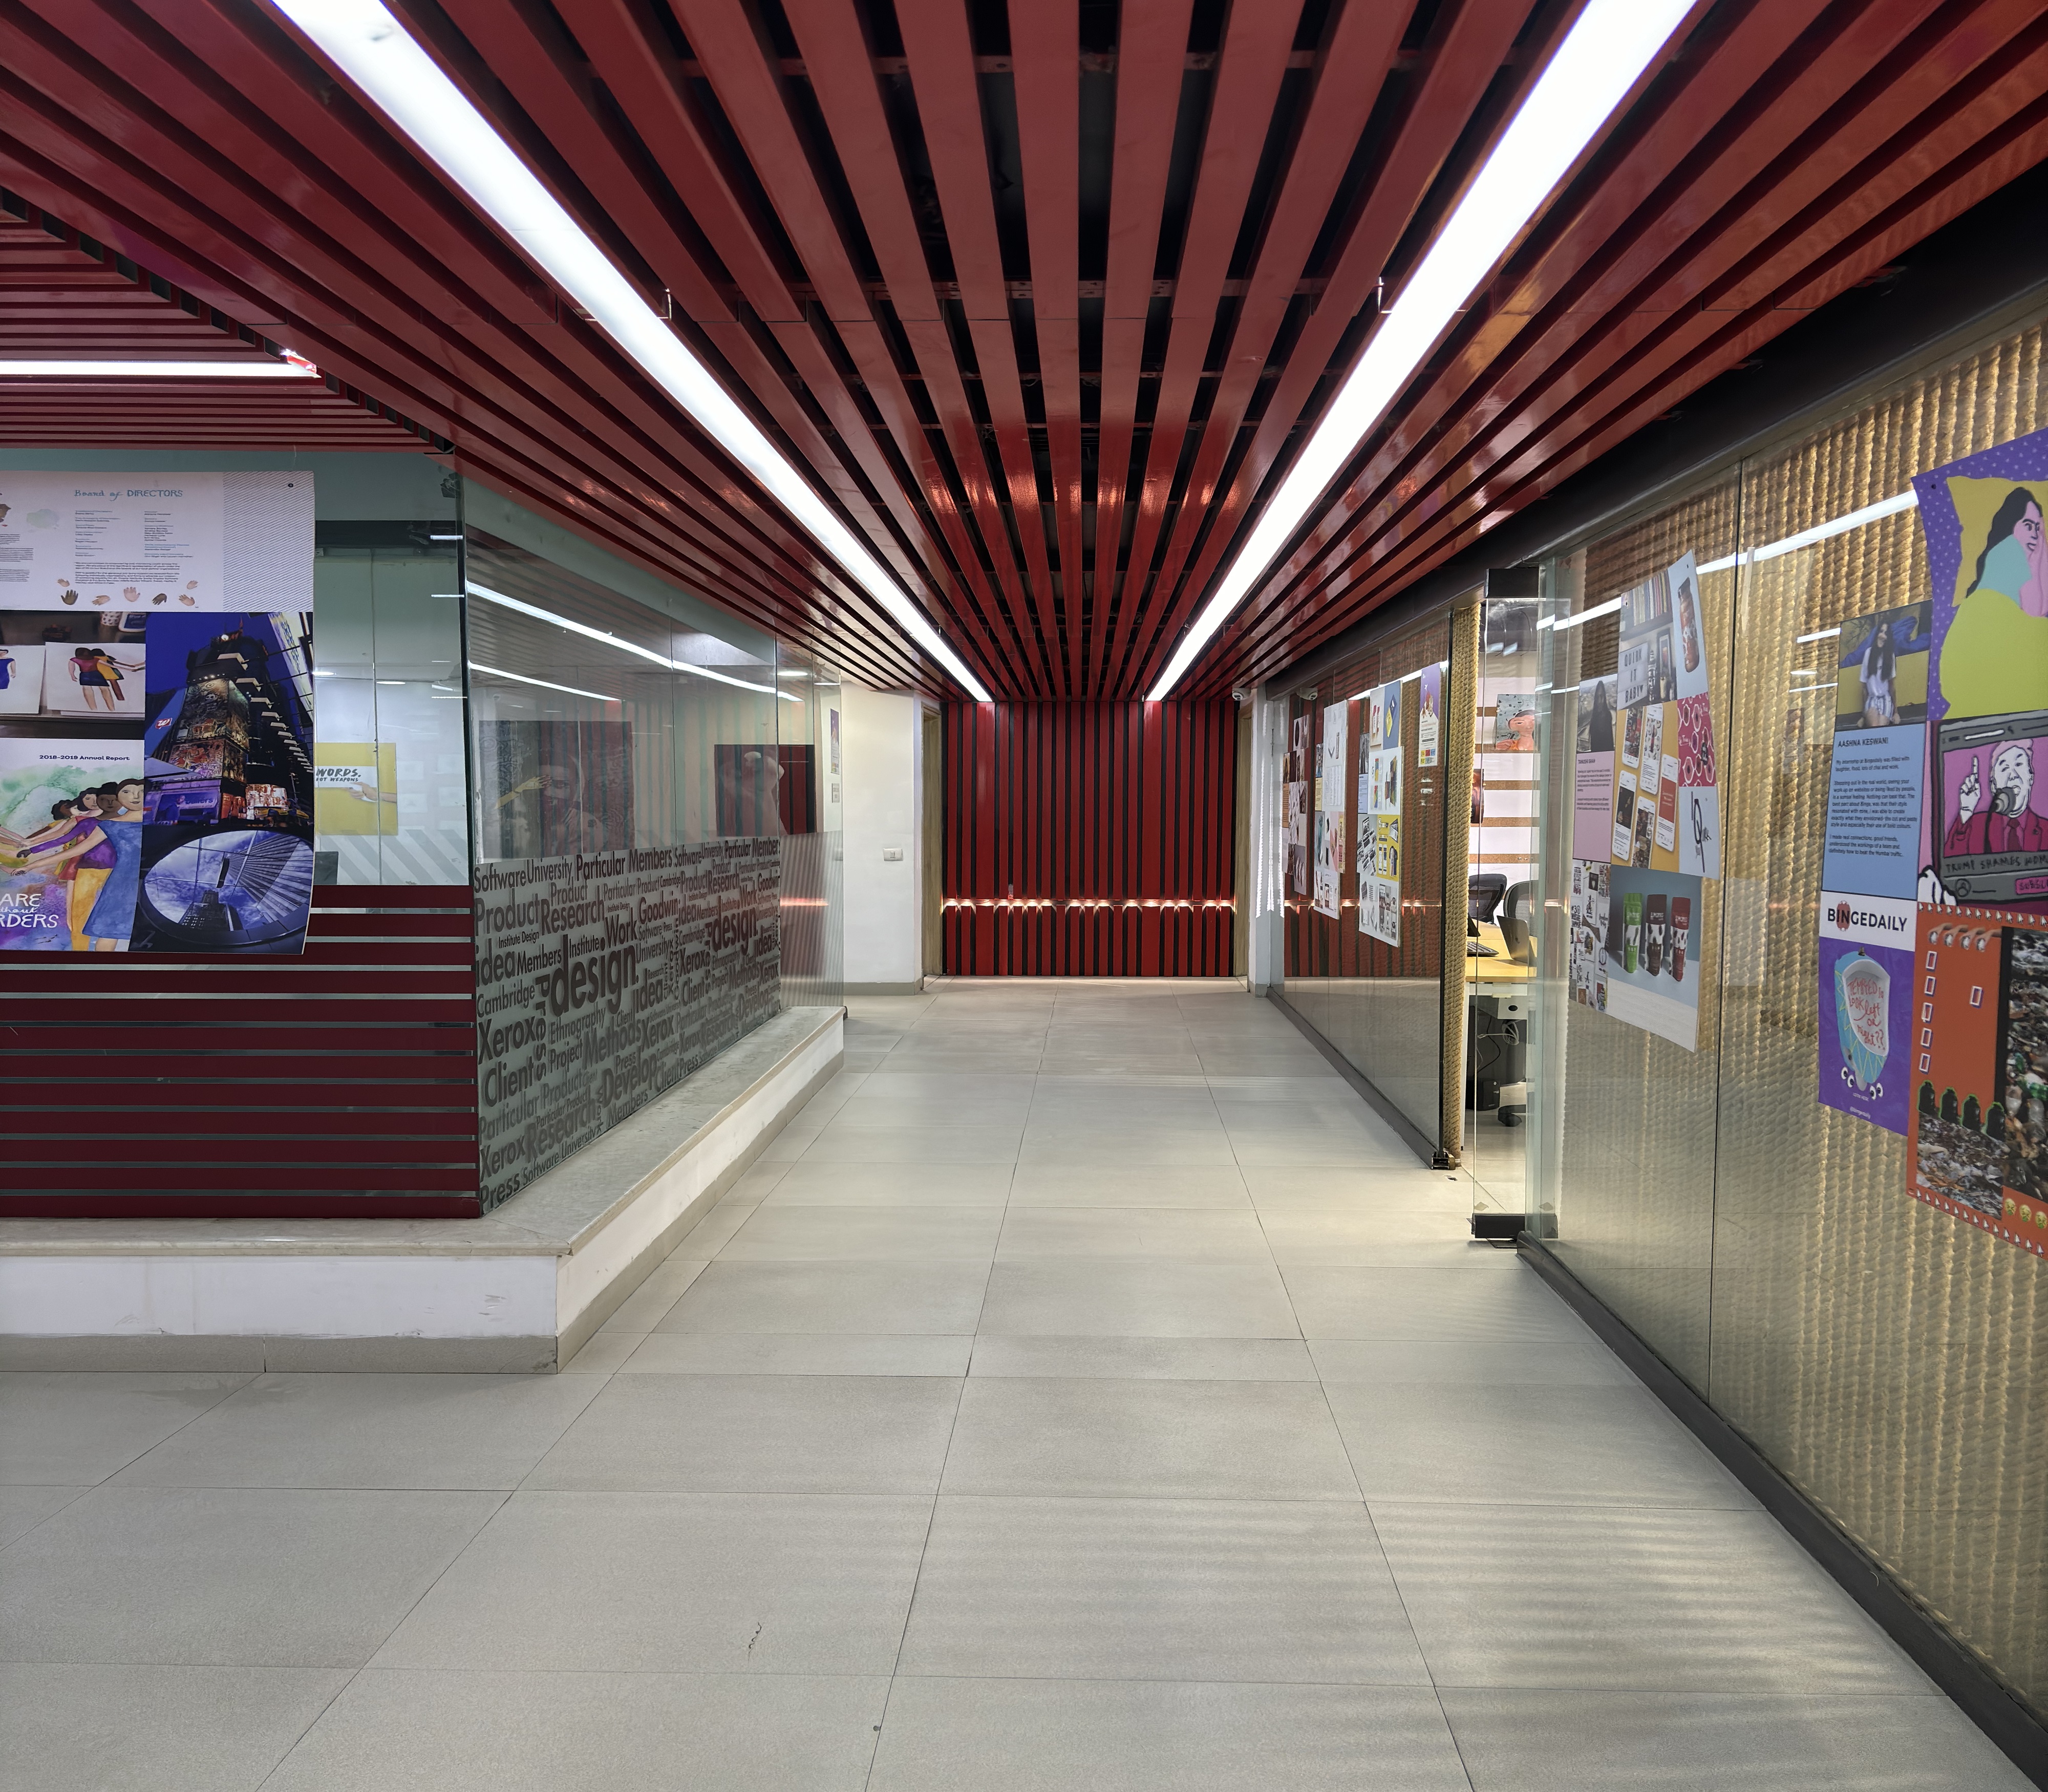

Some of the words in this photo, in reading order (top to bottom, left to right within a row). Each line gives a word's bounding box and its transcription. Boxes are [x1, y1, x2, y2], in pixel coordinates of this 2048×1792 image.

[110, 492, 123, 501] of
[1625, 685, 1640, 703] BABY
[1630, 669, 1636, 682] IT
[1838, 739, 1861, 748] AASHNA
[1862, 737, 1889, 746] KESWANI
[316, 769, 361, 777] WORDS.
[474, 863, 526, 893] Software
[527, 856, 572, 885] University
[577, 850, 626, 881] Particular
[629, 847, 672, 873] Members
[675, 844, 702, 867] Software
[701, 841, 723, 861] University
[725, 839, 751, 859] Particular
[550, 876, 588, 906] Product
[604, 876, 635, 901] Particular
[637, 873, 659, 894] Product
[660, 872, 681, 888] Cambridge
[0, 893, 41, 907] ARE
[475, 888, 540, 936] Product
[541, 885, 605, 936] Research
[680, 866, 709, 893] Product
[708, 863, 740, 894] Research
[499, 932, 521, 949] Institute
[522, 928, 540, 945] Design
[605, 907, 637, 948] Work
[638, 923, 662, 941] Software
[664, 921, 672, 933] Press
[679, 893, 697, 926] idea
[639, 890, 678, 925] Goodwin
[740, 880, 758, 908] Work
[1827, 908, 1907, 932] BINGEDAILY
[476, 938, 515, 987] idea
[517, 944, 562, 976] Members
[569, 934, 600, 958] Institute
[636, 934, 670, 964] University
[679, 924, 706, 946] Cambridge
[477, 979, 535, 1018] Cambridge
[679, 947, 706, 977] Xerox
[478, 1016, 536, 1065] Xerox
[550, 1002, 606, 1044] Ethnography
[616, 1009, 633, 1028] Client
[635, 968, 664, 1013] idea
[682, 977, 705, 1007] Client
[536, 974, 550, 1081] Press
[484, 1056, 534, 1107] Client
[550, 1038, 583, 1073] Project
[583, 1016, 641, 1071] Methods
[641, 1015, 674, 1052] Xerox
[537, 1103, 565, 1127] Particular
[602, 1046, 657, 1109] Develop
[679, 1054, 698, 1078] Press
[479, 1091, 539, 1146] Particular
[543, 1069, 582, 1109] Product
[616, 1051, 636, 1074] Press
[480, 1135, 525, 1182] Xerox
[526, 1085, 596, 1163] Research
[480, 1173, 520, 1215] Press
[523, 1153, 559, 1186] Software
